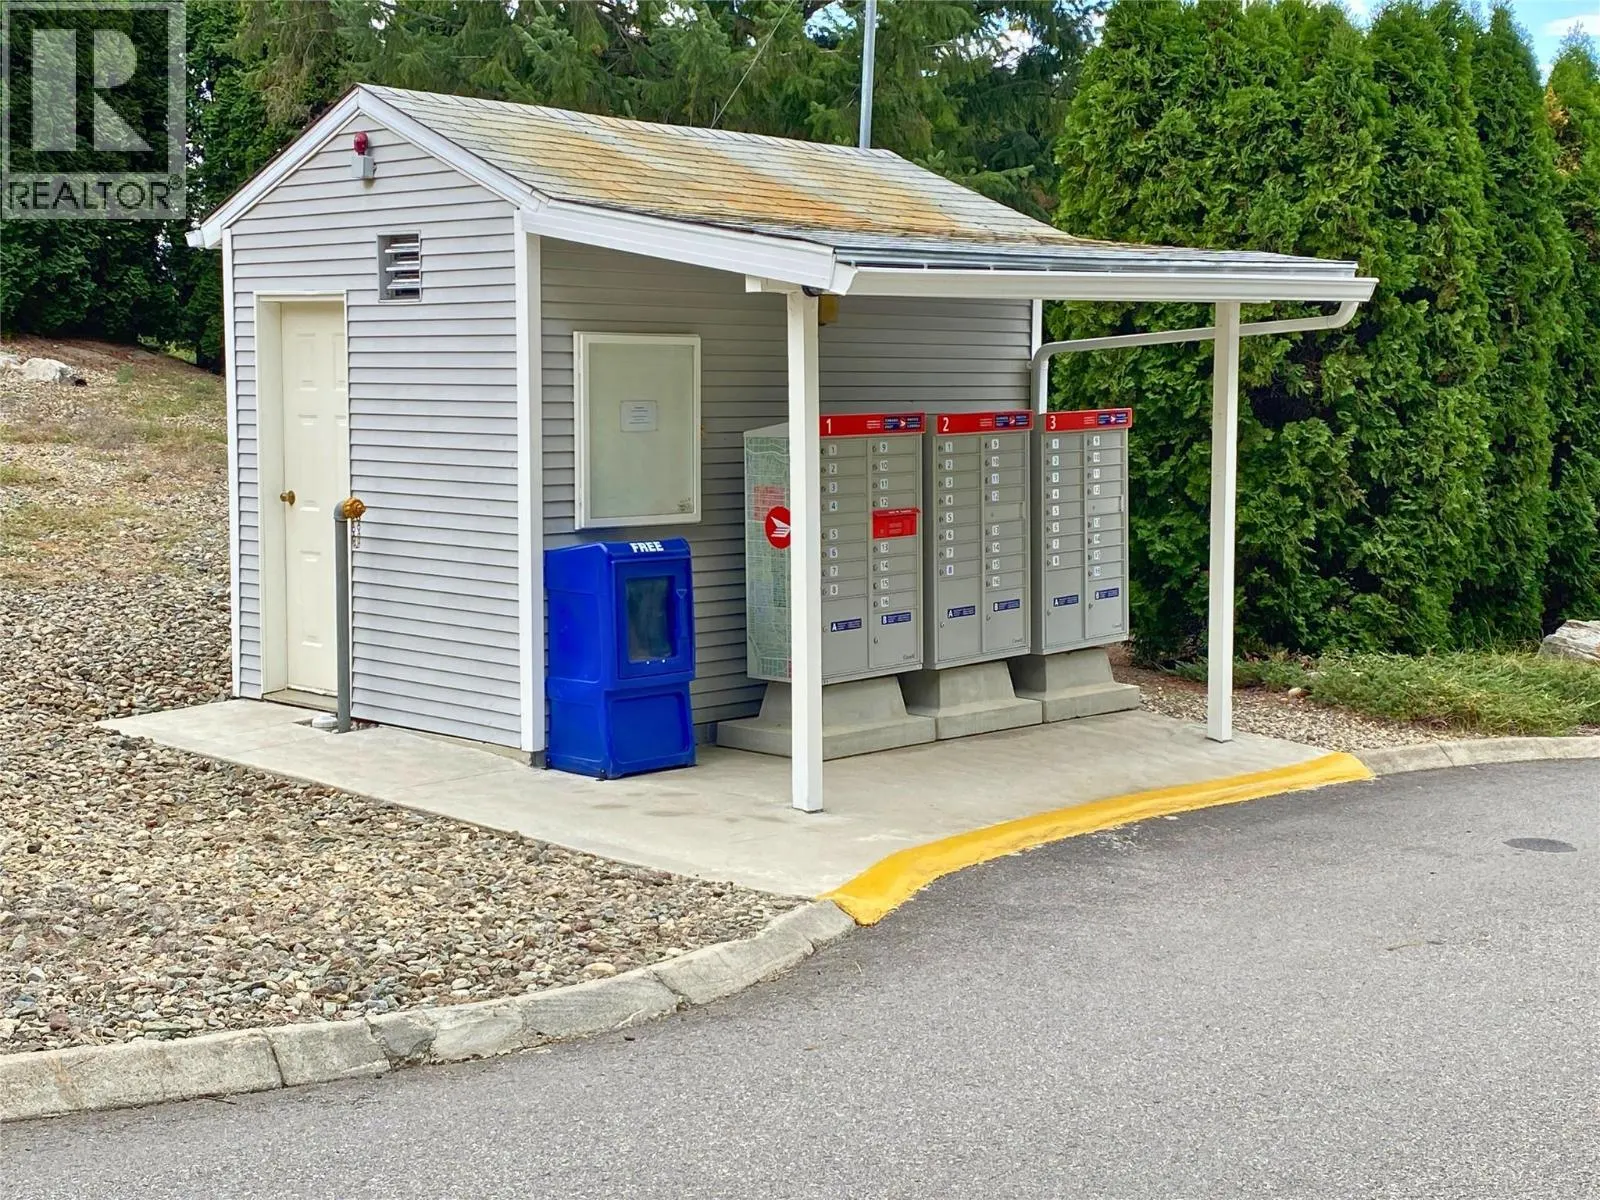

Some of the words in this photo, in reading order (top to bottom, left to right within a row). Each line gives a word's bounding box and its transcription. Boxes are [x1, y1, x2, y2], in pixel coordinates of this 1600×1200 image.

[826, 418, 832, 434] 1
[942, 416, 950, 432] 2
[1050, 415, 1056, 430] 3
[629, 541, 664, 553] FREE
